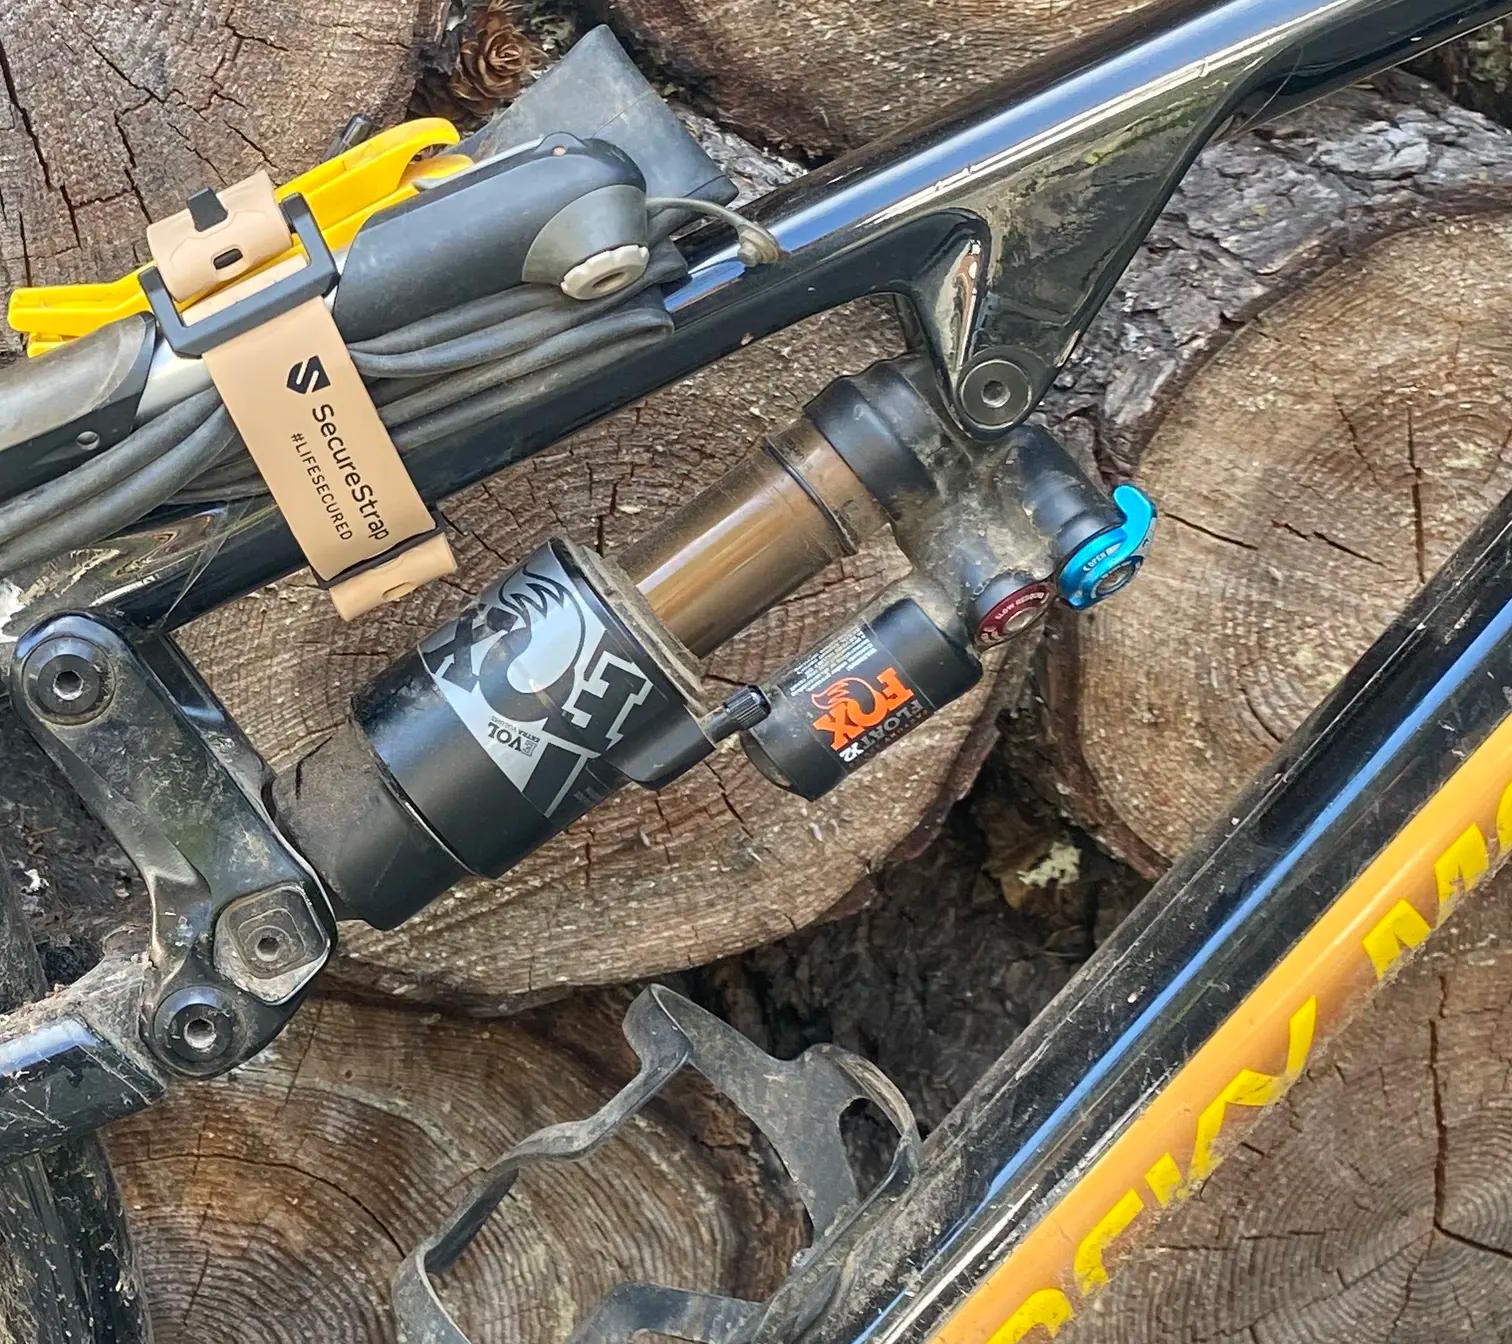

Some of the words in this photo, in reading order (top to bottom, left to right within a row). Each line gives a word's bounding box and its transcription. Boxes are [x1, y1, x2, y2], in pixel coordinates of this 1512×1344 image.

[290, 431, 354, 542] #LIFESECURED
[311, 402, 390, 542] SecureStrap
[486, 719, 539, 757] EVOL
[810, 666, 915, 752] FOX
[862, 699, 924, 750] FLOAT
[839, 741, 865, 763] X2
